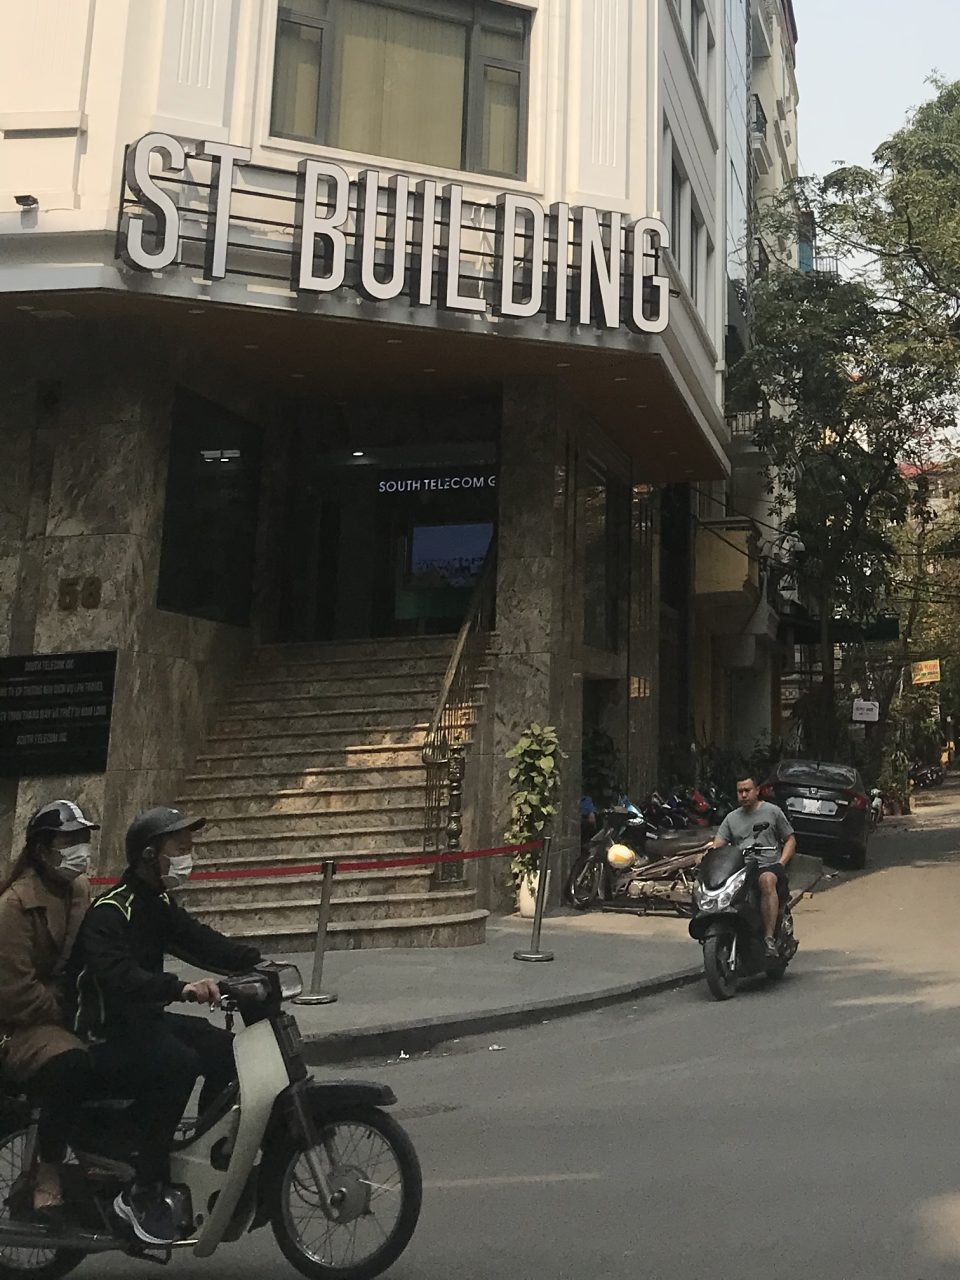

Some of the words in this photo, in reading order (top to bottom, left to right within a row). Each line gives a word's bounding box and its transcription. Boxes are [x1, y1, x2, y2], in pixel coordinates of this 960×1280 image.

[124, 131, 251, 280] ST
[297, 158, 671, 334] BUILDING
[378, 480, 421, 493] SOUTH
[424, 477, 484, 491] TELECOM
